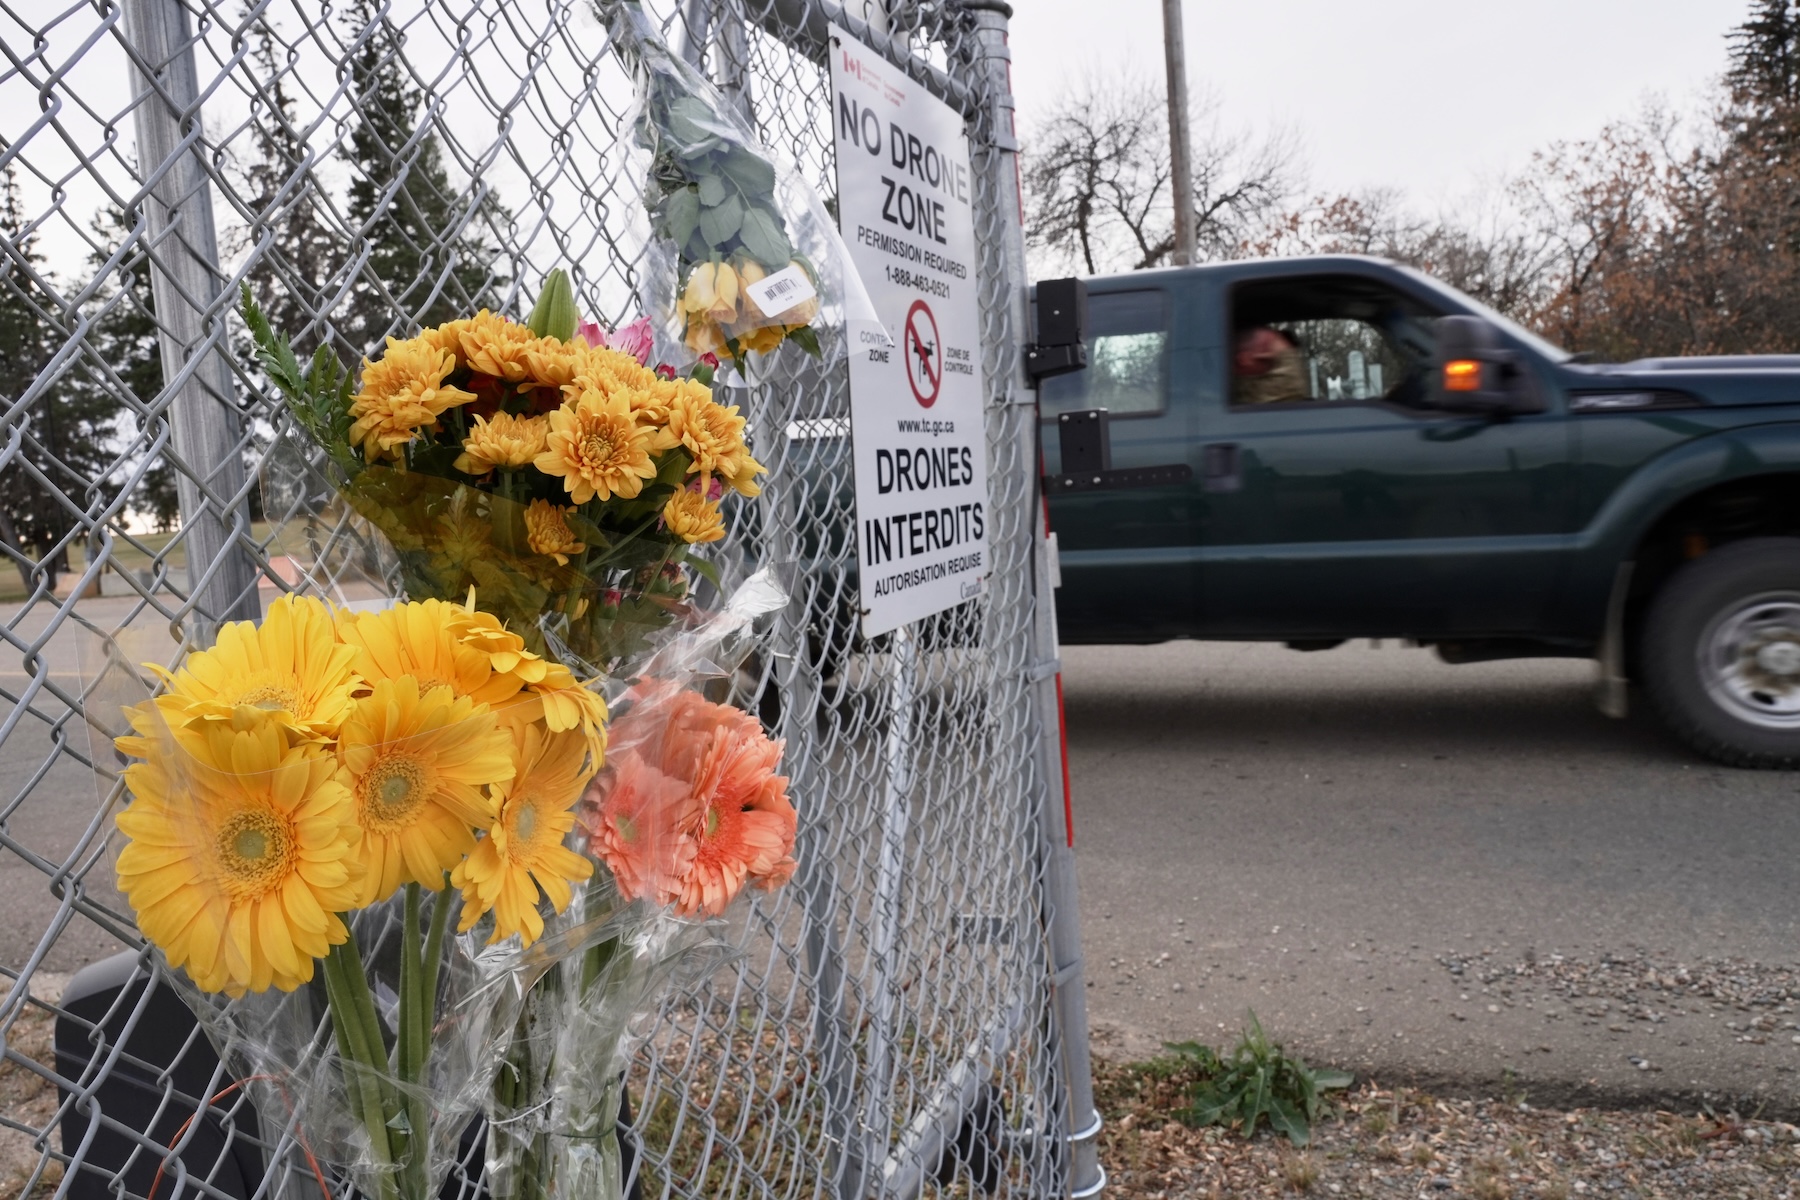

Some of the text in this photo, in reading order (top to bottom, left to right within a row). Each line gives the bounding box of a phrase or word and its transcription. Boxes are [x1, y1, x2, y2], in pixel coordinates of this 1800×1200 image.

[839, 91, 968, 205] NO DRONE
[881, 175, 947, 245] ZONE
[858, 225, 967, 280] PERMISSION REQUIRED
[885, 264, 950, 299] 1-888-463-0521
[869, 349, 889, 363] ZONE
[947, 347, 970, 361] ZONE DE
[898, 418, 954, 437] www.tc.gc.ca
[876, 446, 973, 495] DRONES
[865, 502, 984, 567] INTERDITS
[874, 552, 982, 598] AUTORISATION REQUISE
